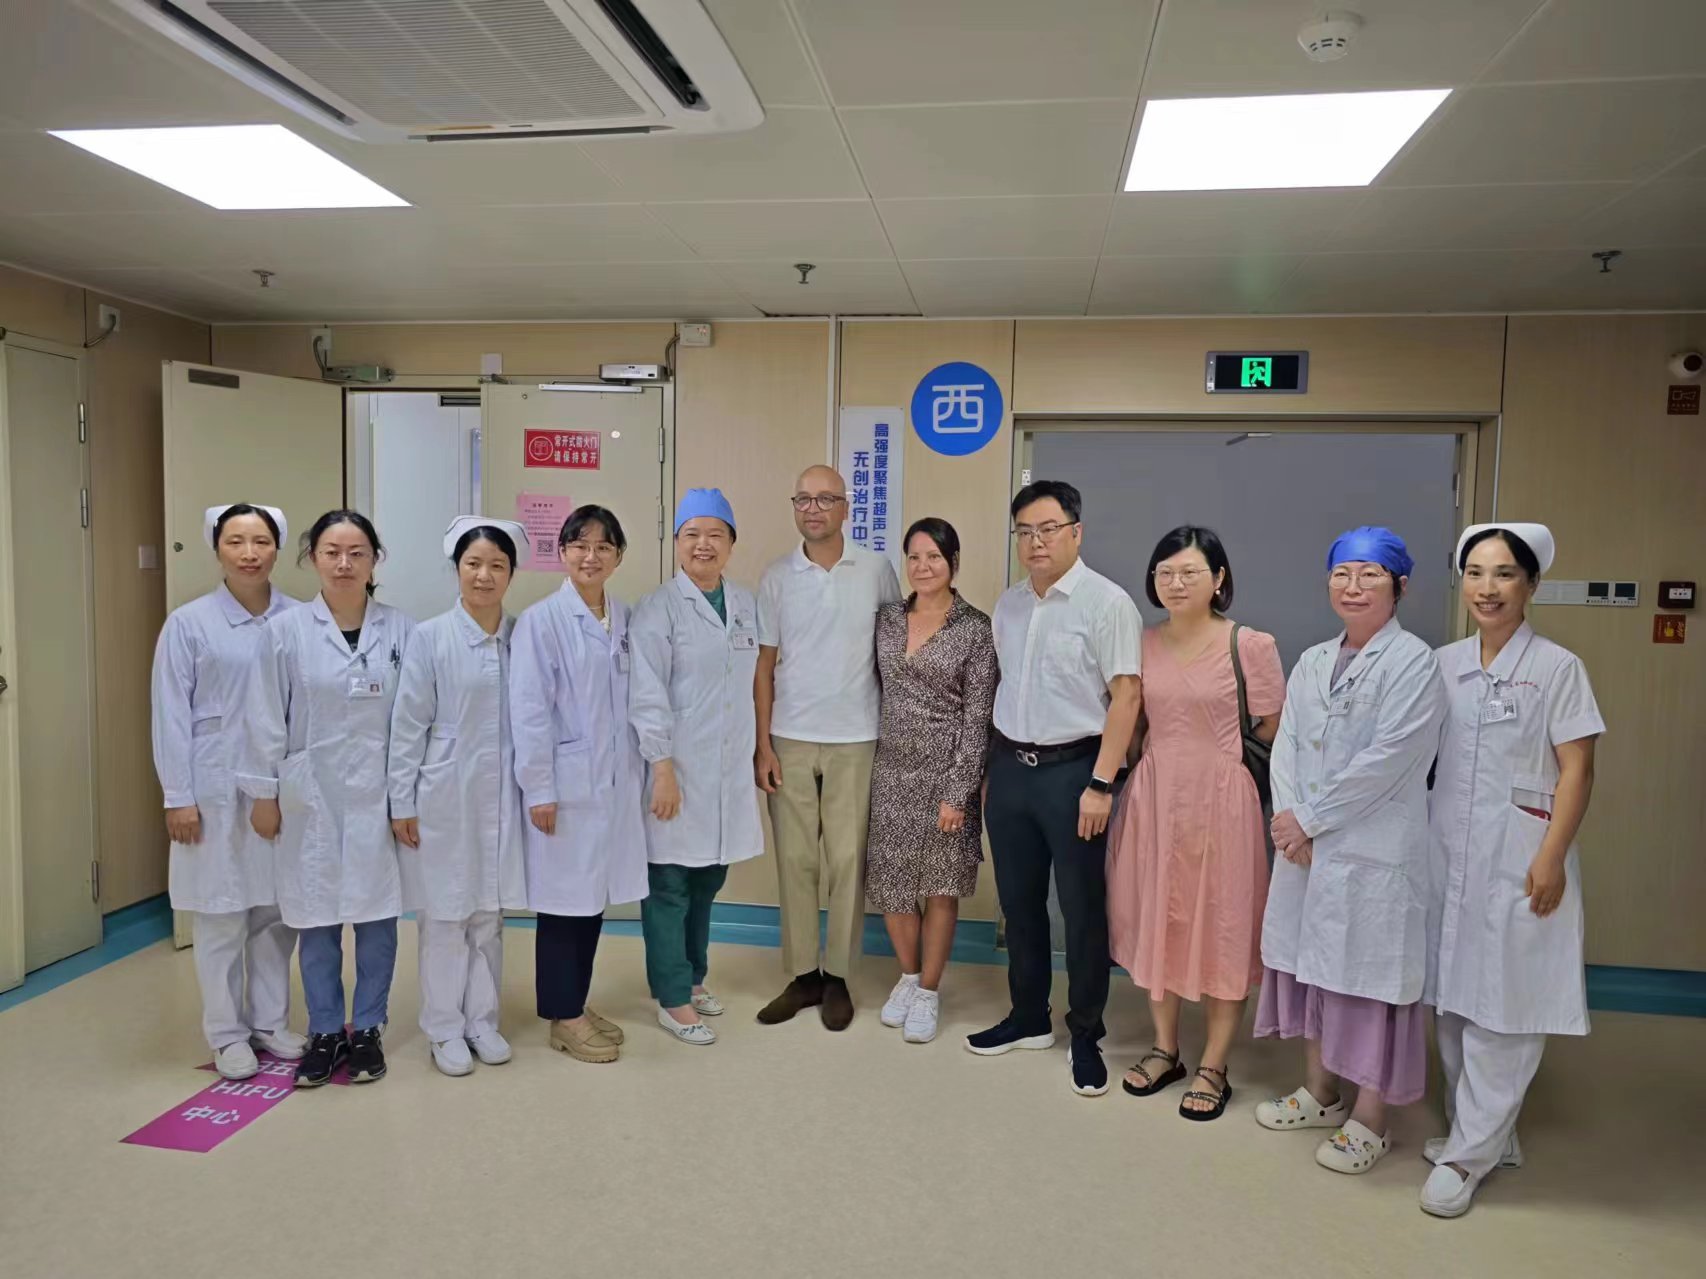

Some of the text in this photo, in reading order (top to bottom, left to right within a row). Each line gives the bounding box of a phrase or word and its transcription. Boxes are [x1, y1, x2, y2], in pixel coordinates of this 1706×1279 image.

[931, 383, 985, 434] 西
[851, 451, 870, 548] 无创治疗中
[210, 1081, 289, 1100] HIFU
[181, 1105, 241, 1125] 中心
